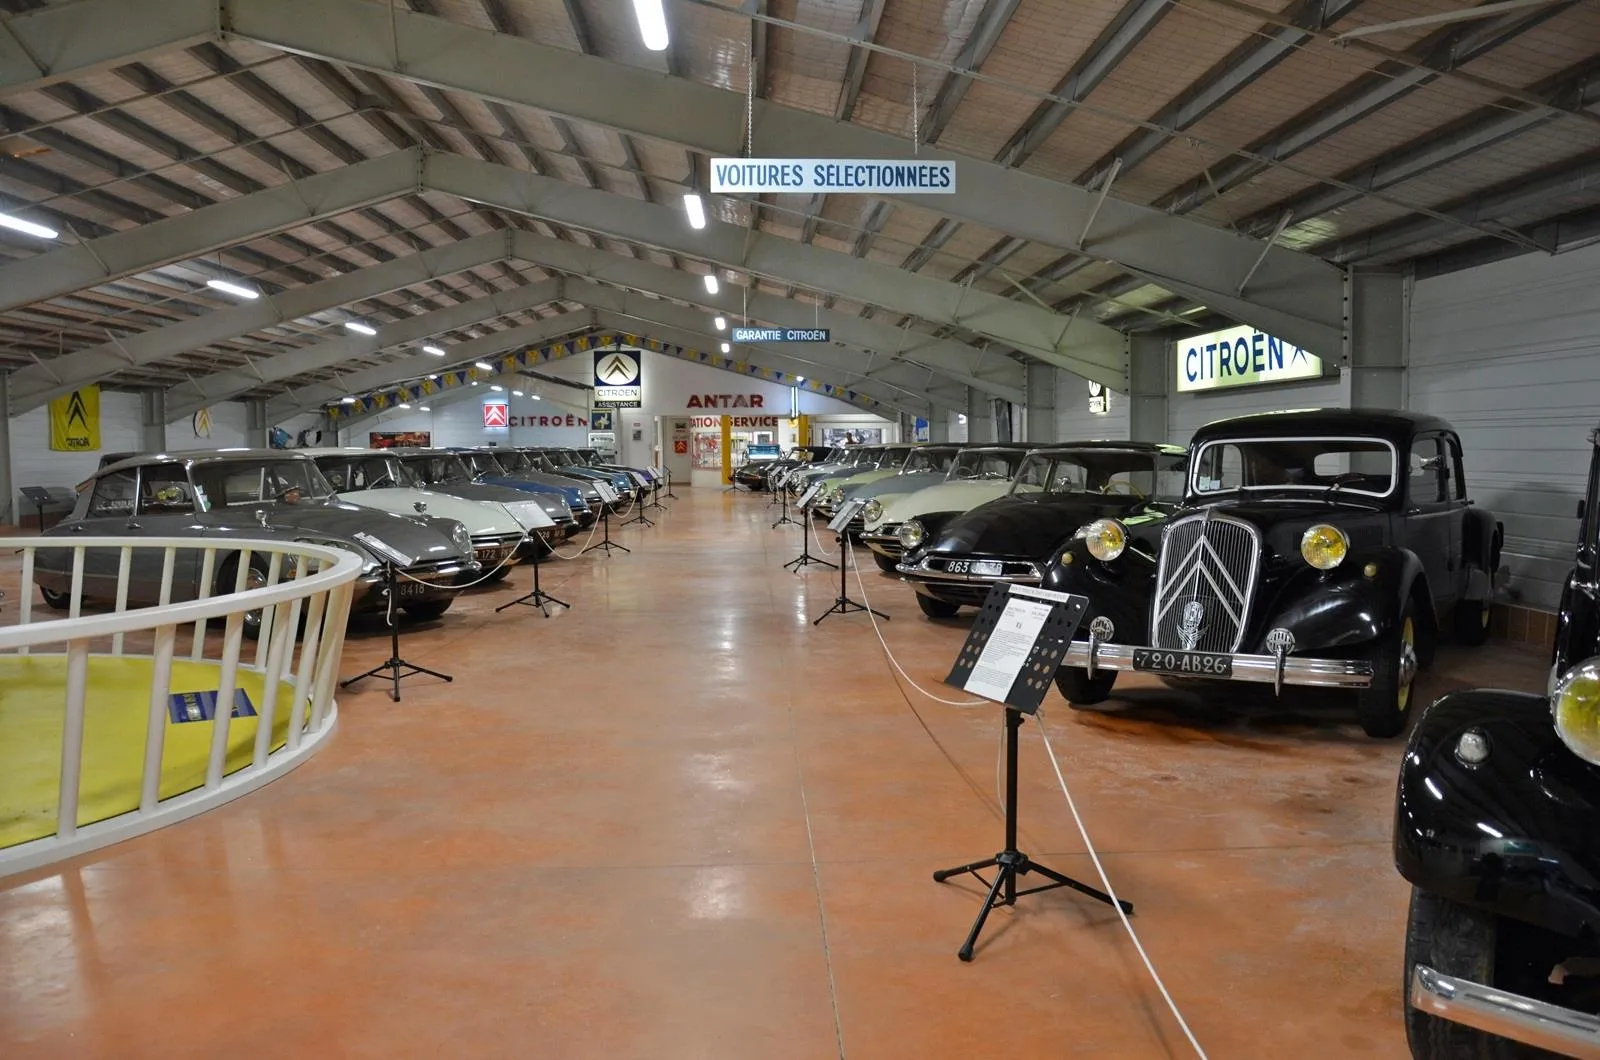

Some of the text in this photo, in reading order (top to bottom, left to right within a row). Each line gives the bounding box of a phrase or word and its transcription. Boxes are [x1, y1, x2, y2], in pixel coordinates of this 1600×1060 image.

[716, 164, 950, 188] VOITURES SÉLECTIONNÉES
[736, 330, 781, 340] GARANTIE
[686, 394, 764, 408] ANTAR
[508, 413, 588, 427] CITROËN
[948, 561, 970, 573] 863
